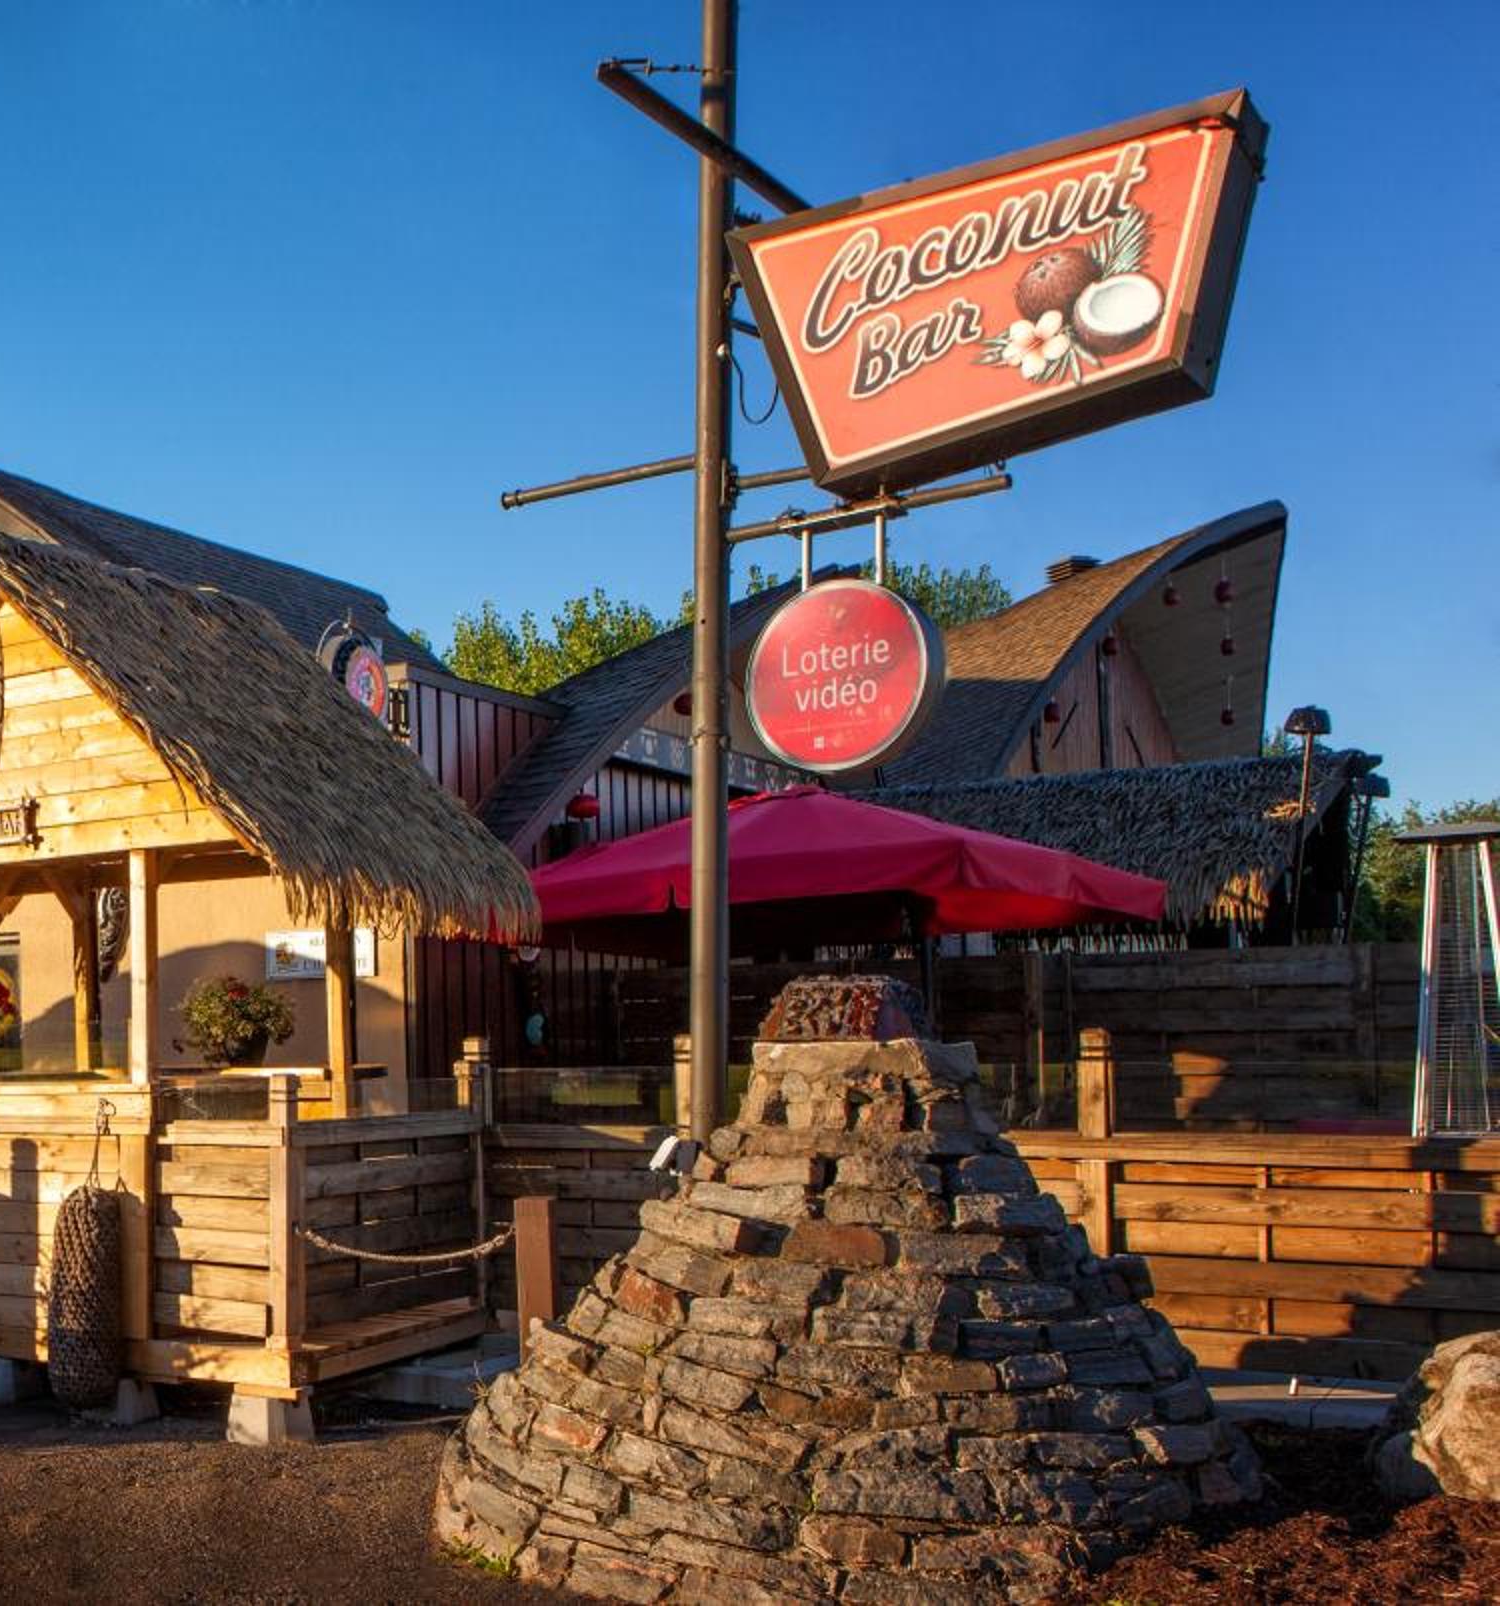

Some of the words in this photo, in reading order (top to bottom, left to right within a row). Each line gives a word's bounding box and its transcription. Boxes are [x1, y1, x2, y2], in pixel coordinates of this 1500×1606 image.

[803, 143, 1146, 352] Coconut
[850, 299, 981, 398] Bar
[783, 634, 889, 677] Loterie
[795, 675, 877, 712] vidéo
